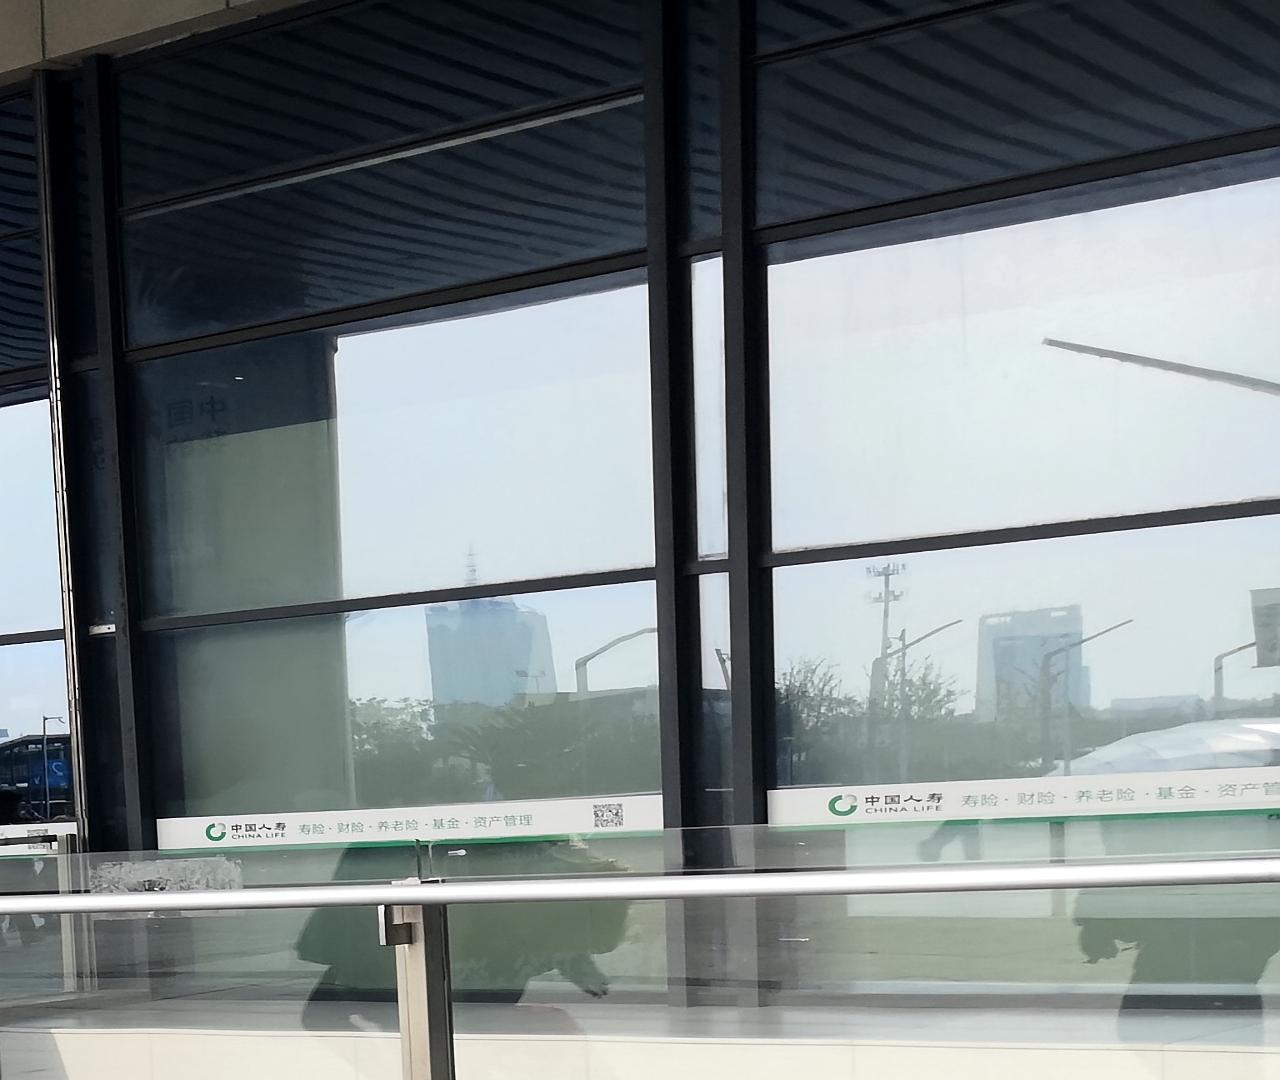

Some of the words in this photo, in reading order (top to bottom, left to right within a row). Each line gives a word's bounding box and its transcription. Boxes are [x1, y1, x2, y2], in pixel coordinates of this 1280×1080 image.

[865, 793, 943, 806] 中国人寿
[865, 806, 908, 814] CHINA
[231, 822, 287, 833] 中国人寿
